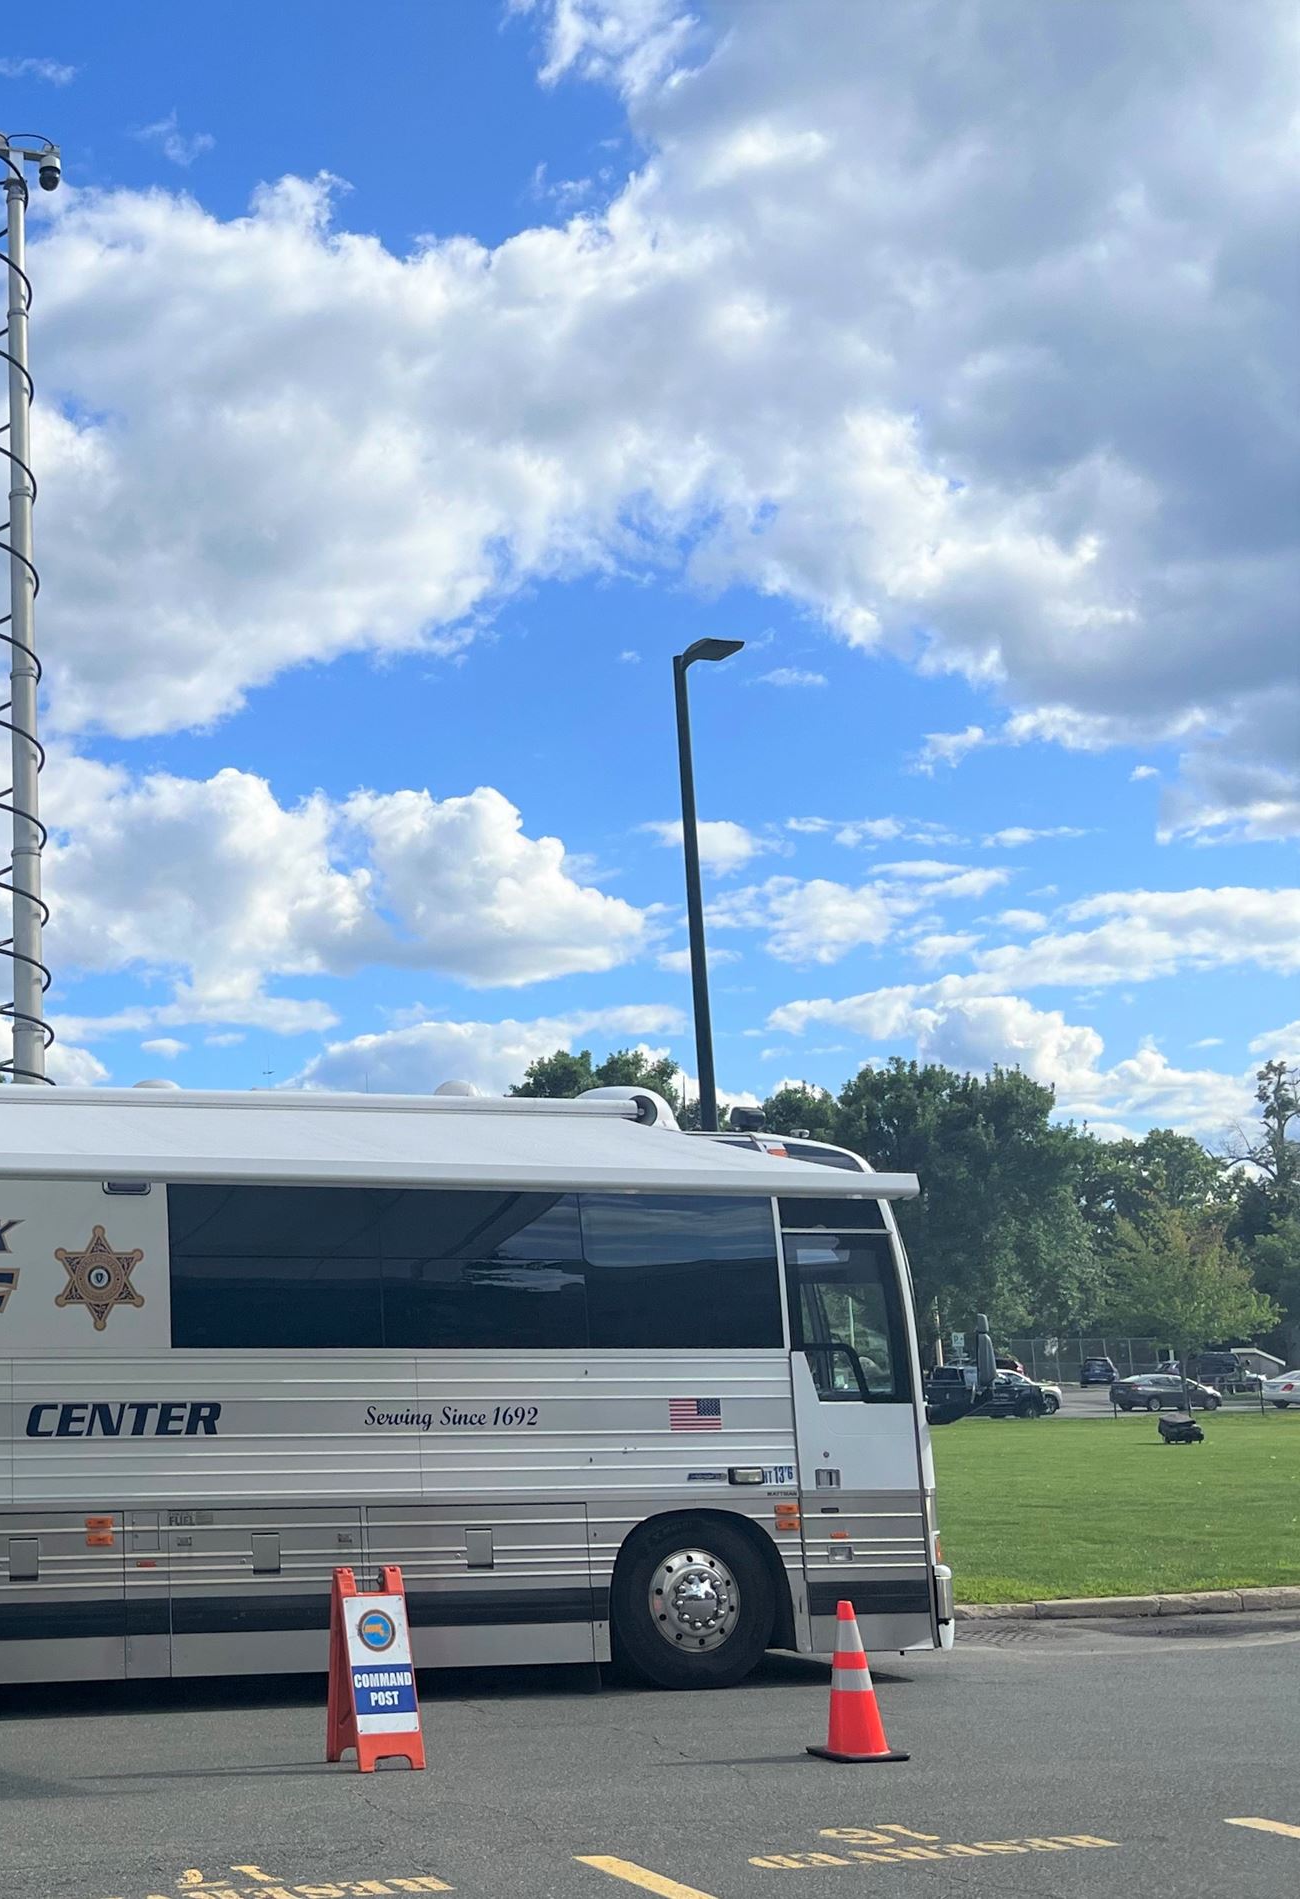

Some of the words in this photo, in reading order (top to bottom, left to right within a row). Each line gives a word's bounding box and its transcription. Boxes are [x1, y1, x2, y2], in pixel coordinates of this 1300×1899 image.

[25, 1402, 223, 1439] CENTER
[364, 1405, 434, 1431] Serving
[439, 1406, 488, 1426] Since
[493, 1406, 539, 1426] 1692
[353, 1671, 413, 1689] COMMAND
[370, 1690, 400, 1707] POST
[747, 1834, 1124, 1870] RESERVED
[100, 1875, 457, 1899] RESER
